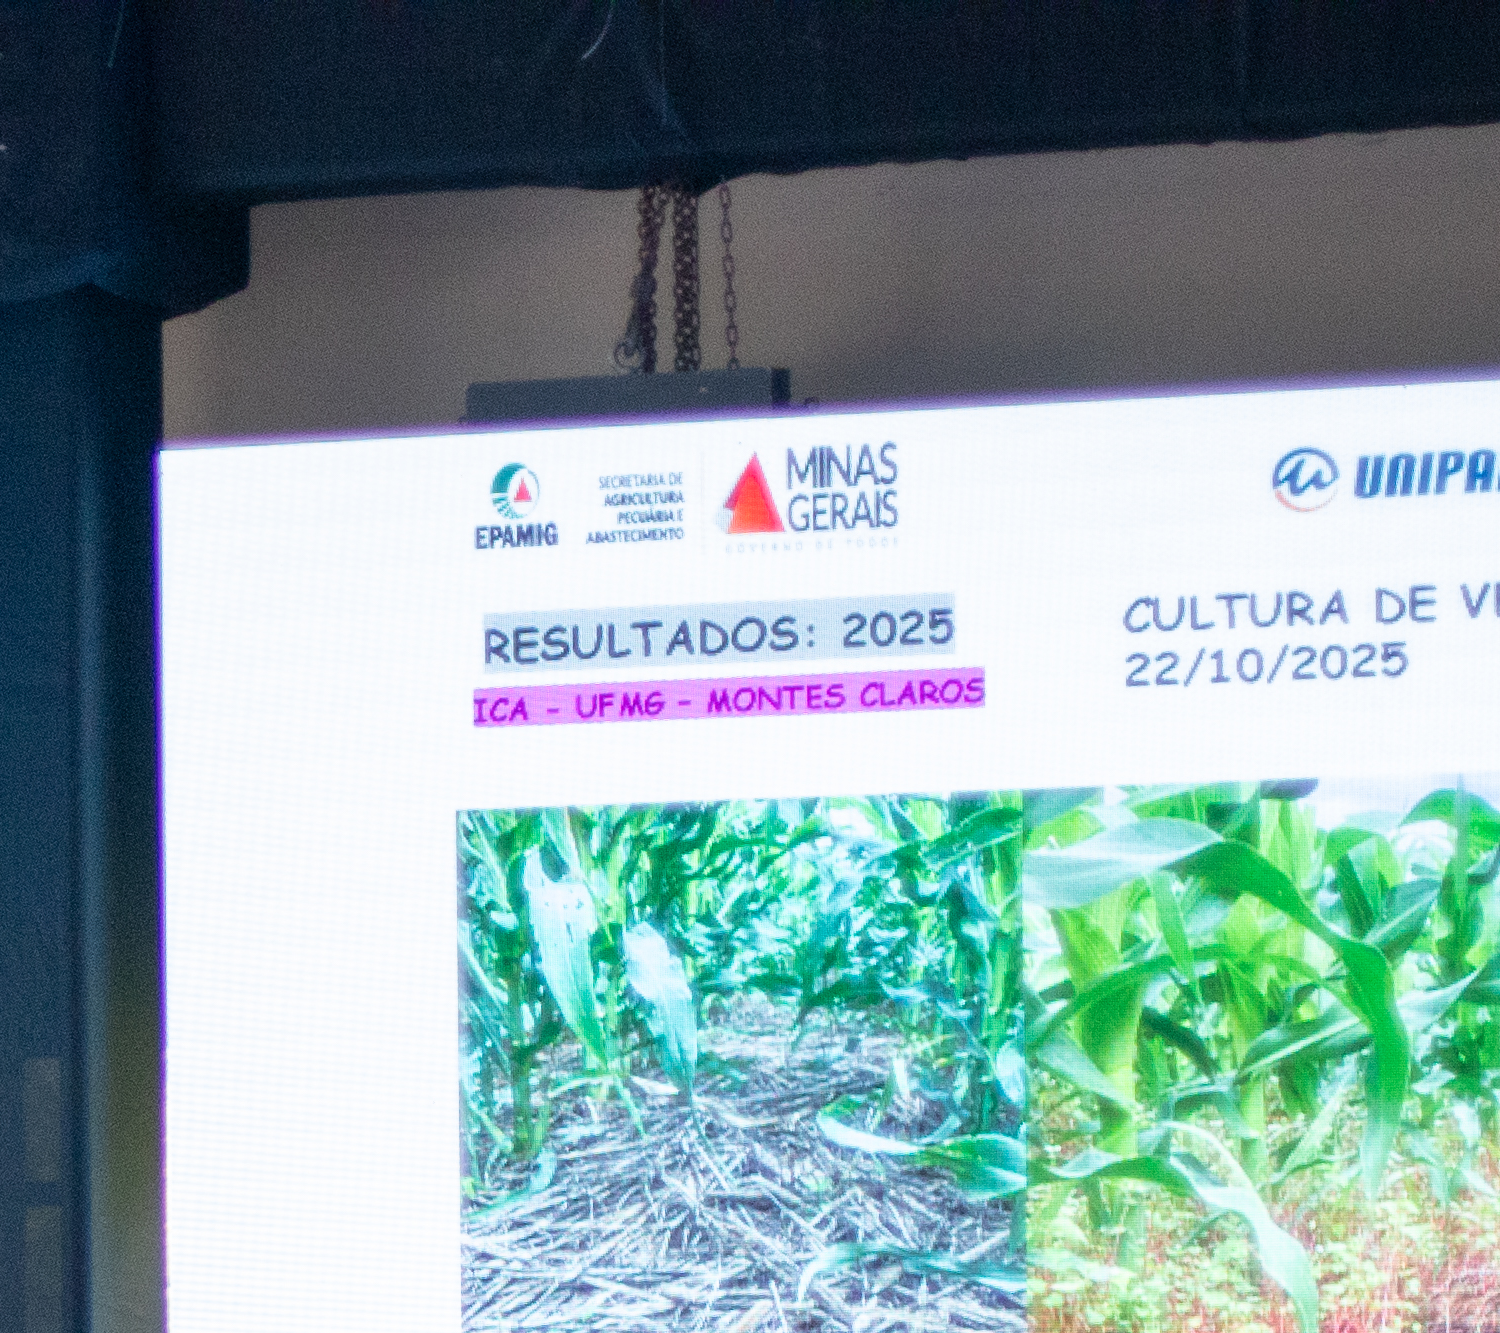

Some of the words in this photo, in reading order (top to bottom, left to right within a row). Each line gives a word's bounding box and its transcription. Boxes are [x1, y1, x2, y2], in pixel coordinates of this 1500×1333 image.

[787, 441, 898, 489] MINAS
[1355, 449, 1500, 498] UNIPA
[787, 489, 898, 532] GERAIS
[476, 522, 558, 549] EPAMIG
[1123, 590, 1349, 633] CULTURA
[1376, 585, 1436, 624] DE
[485, 615, 815, 665] RESULTADOS:
[843, 608, 953, 648] 2025
[1126, 641, 1409, 687] 22/10/2025
[474, 697, 528, 723] ICA
[575, 691, 666, 722] UFMG
[707, 684, 846, 714] MONTES
[860, 678, 986, 706] CLAROS
